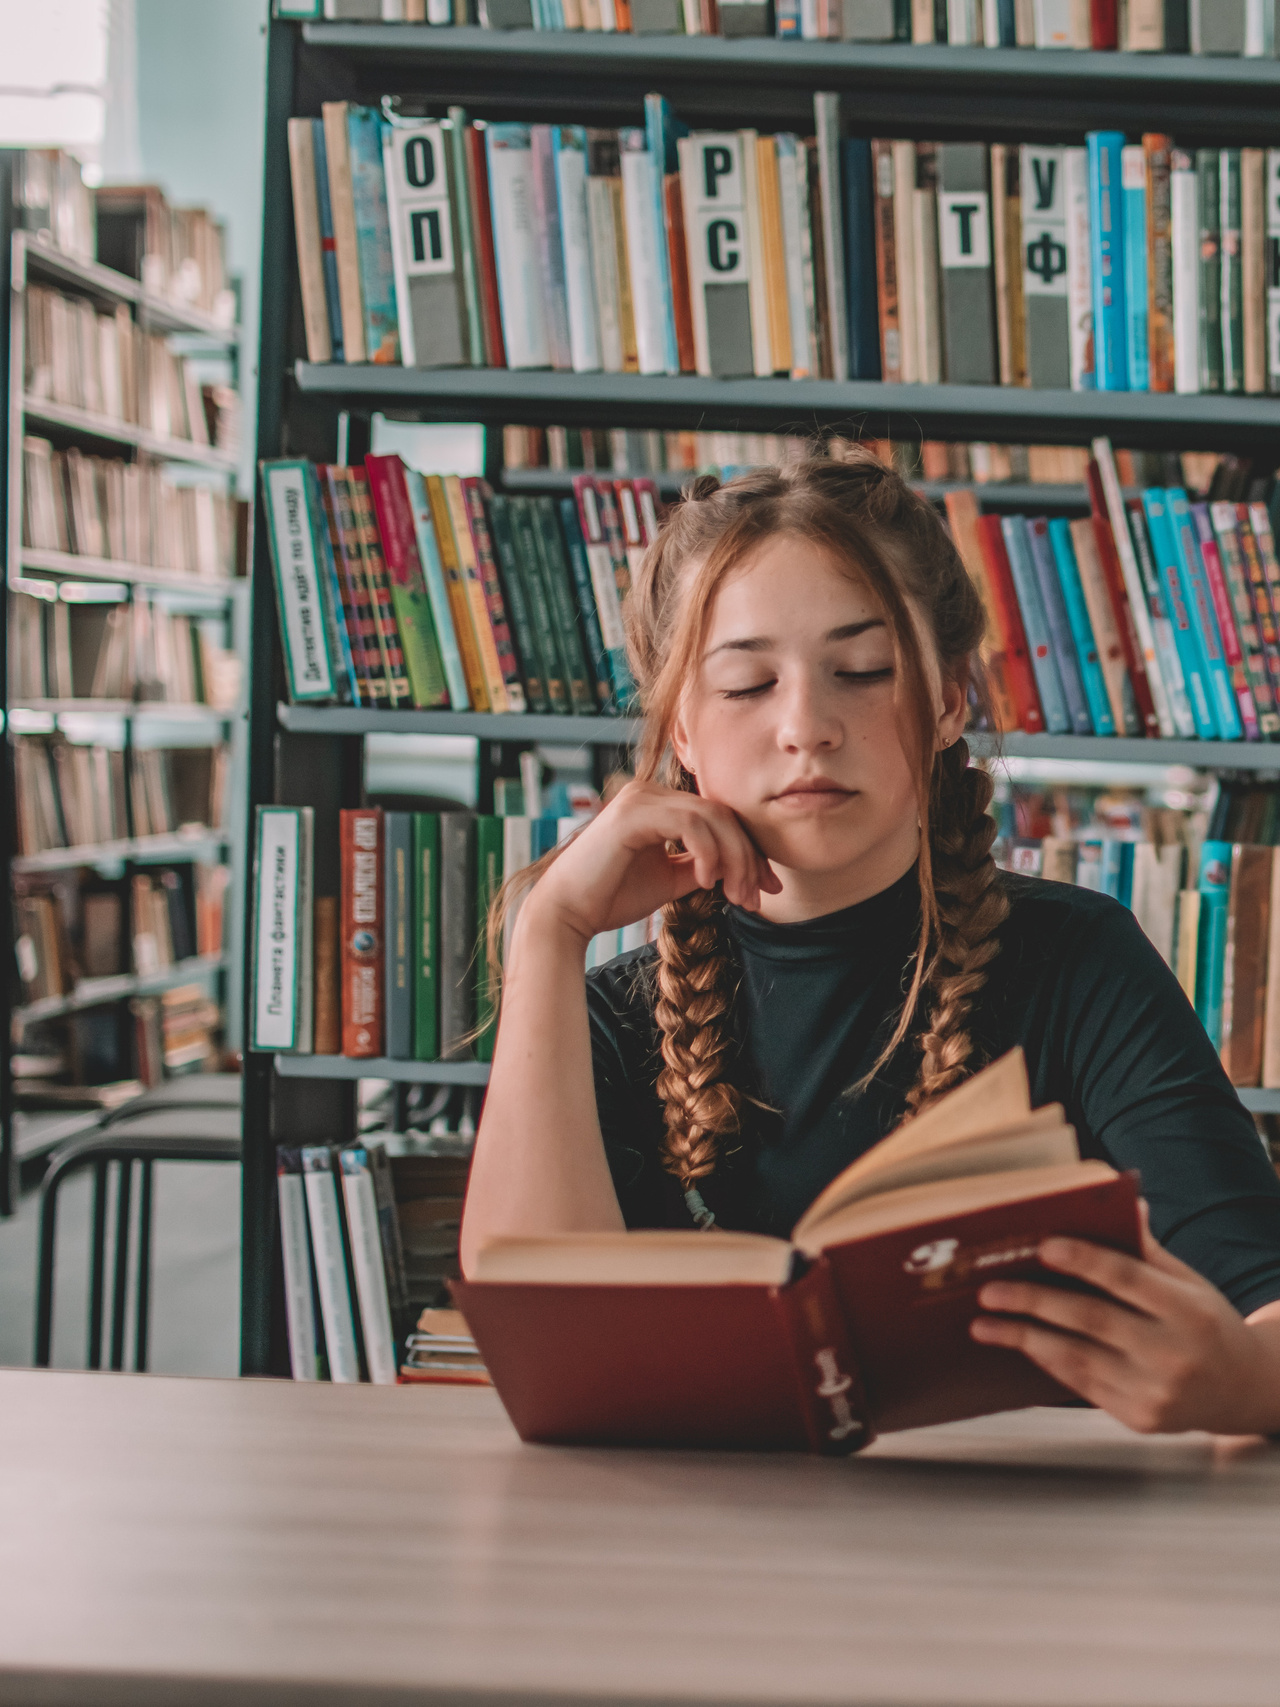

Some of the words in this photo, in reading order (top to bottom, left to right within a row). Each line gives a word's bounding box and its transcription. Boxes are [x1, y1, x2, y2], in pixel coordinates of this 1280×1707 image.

[404, 134, 436, 189] О
[702, 145, 733, 198] Р
[1031, 158, 1057, 211] У
[410, 209, 443, 262] П
[706, 219, 739, 273] С
[950, 204, 978, 255] Т
[1026, 231, 1068, 284] Ф
[270, 846, 286, 942] фантастики
[267, 948, 284, 1015] Планета
